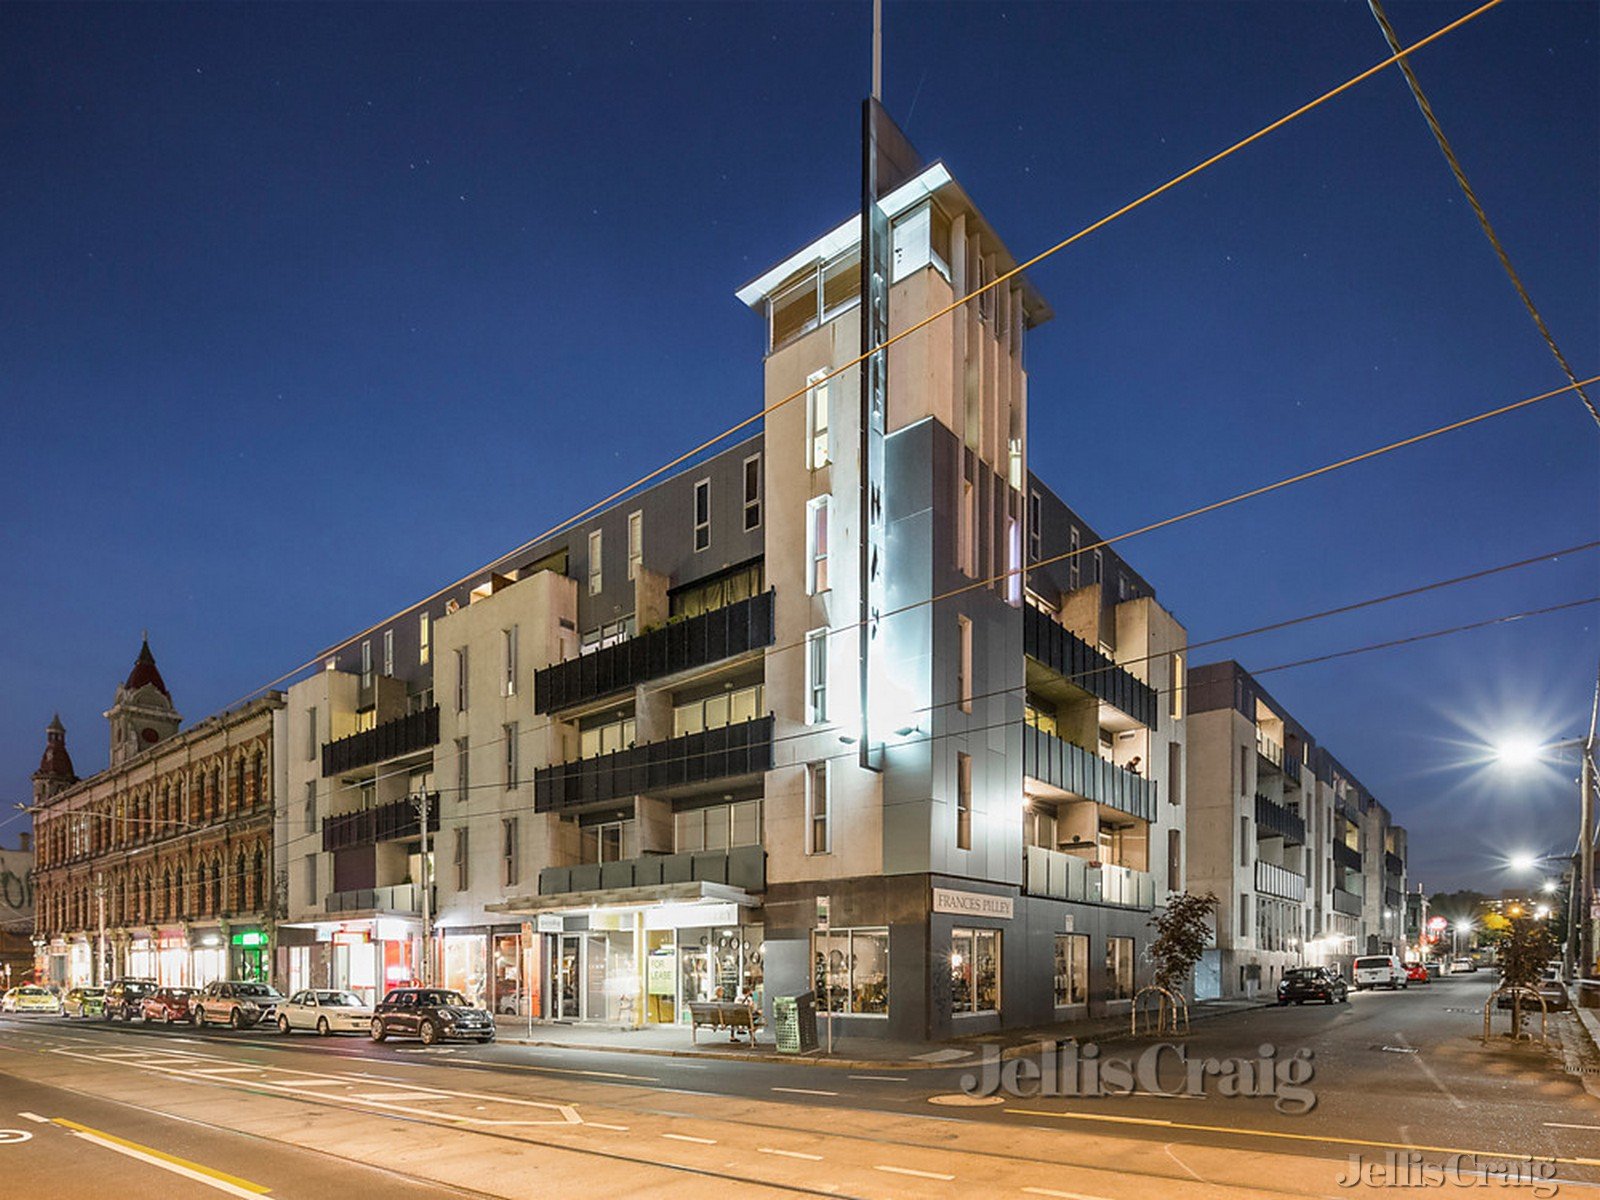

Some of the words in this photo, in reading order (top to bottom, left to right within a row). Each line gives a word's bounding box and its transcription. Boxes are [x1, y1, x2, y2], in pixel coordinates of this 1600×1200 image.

[938, 894, 982, 911] FRANCES
[983, 899, 1010, 914] PILLEY
[651, 959, 665, 968] FOR
[651, 970, 672, 980] LEASE
